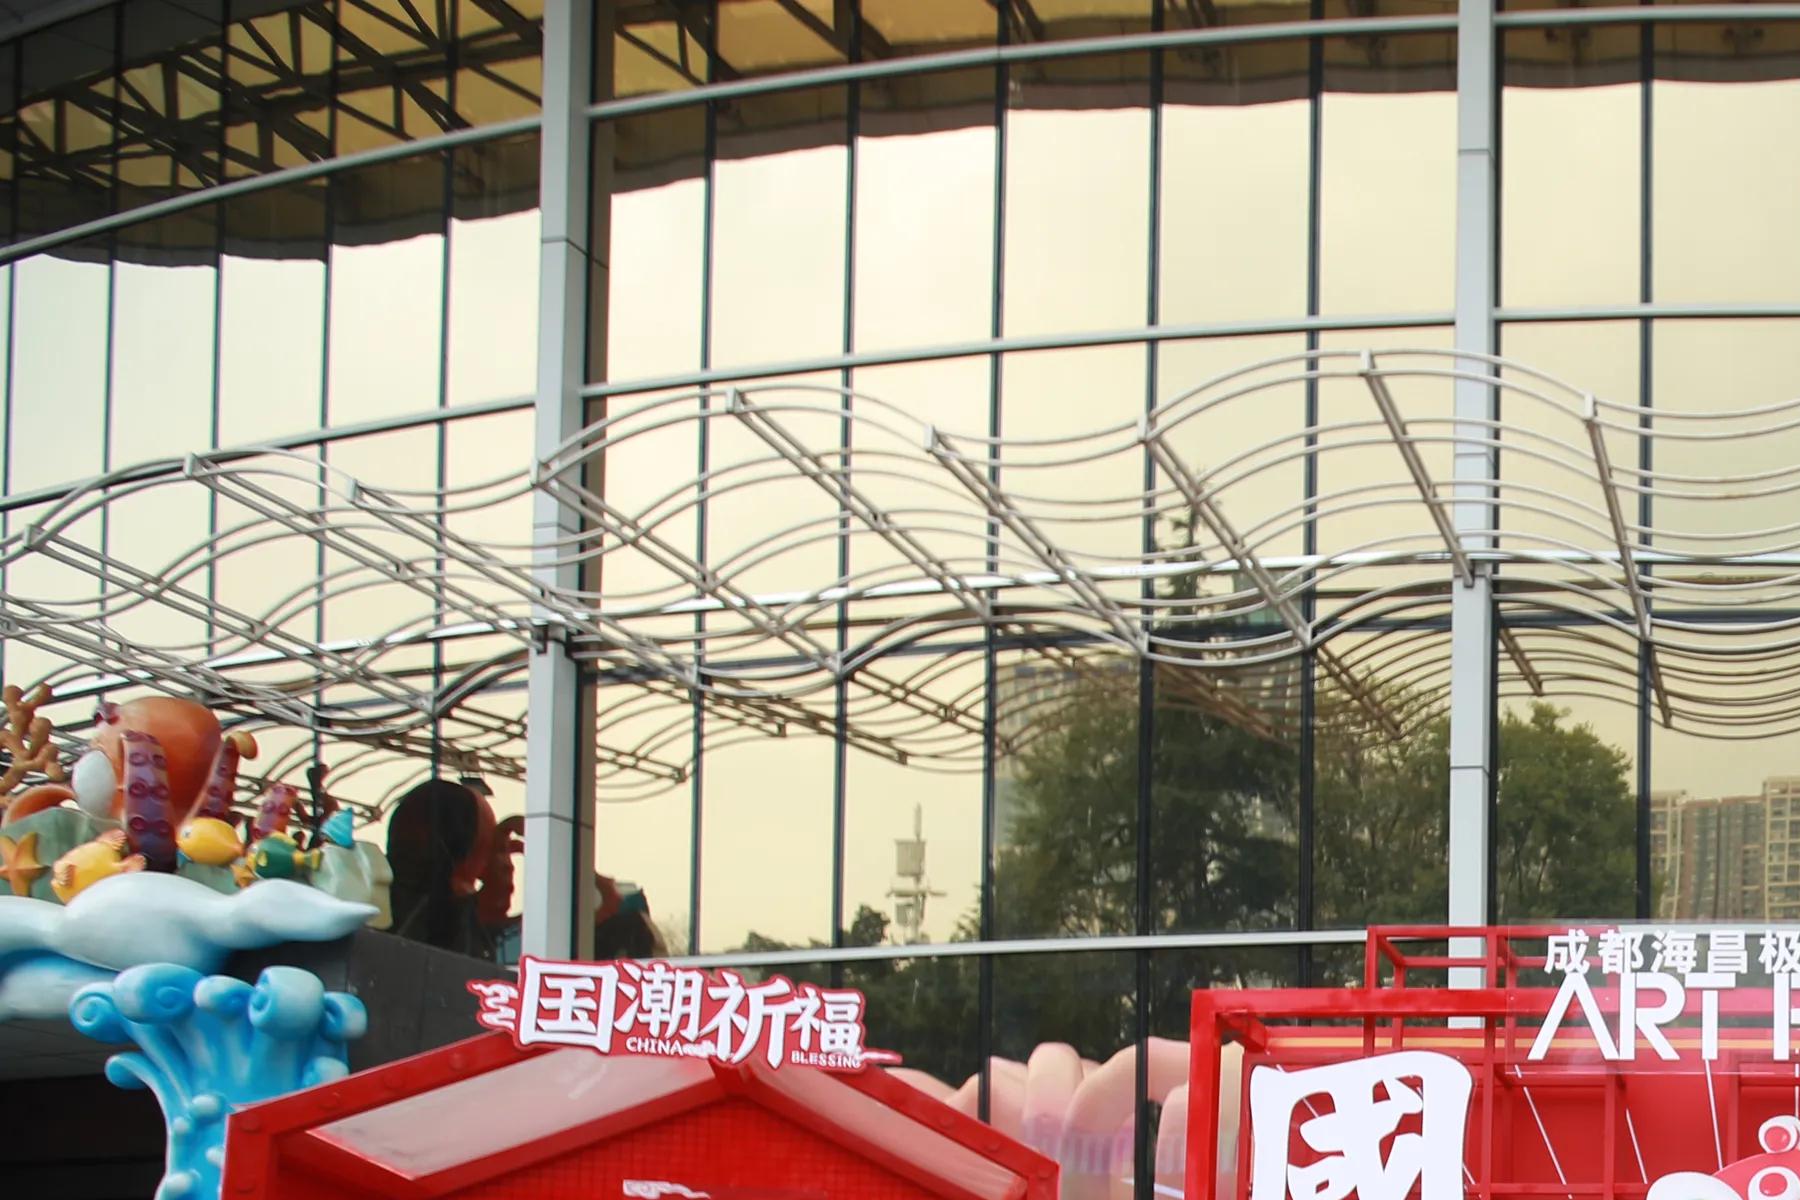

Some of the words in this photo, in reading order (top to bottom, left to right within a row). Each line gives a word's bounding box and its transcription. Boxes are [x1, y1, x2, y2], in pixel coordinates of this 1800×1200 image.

[518, 957, 863, 1069] 国潮祈福
[1526, 971, 1736, 1061] ART
[625, 1036, 684, 1057] CHINA
[791, 1049, 861, 1069] BLESSING
